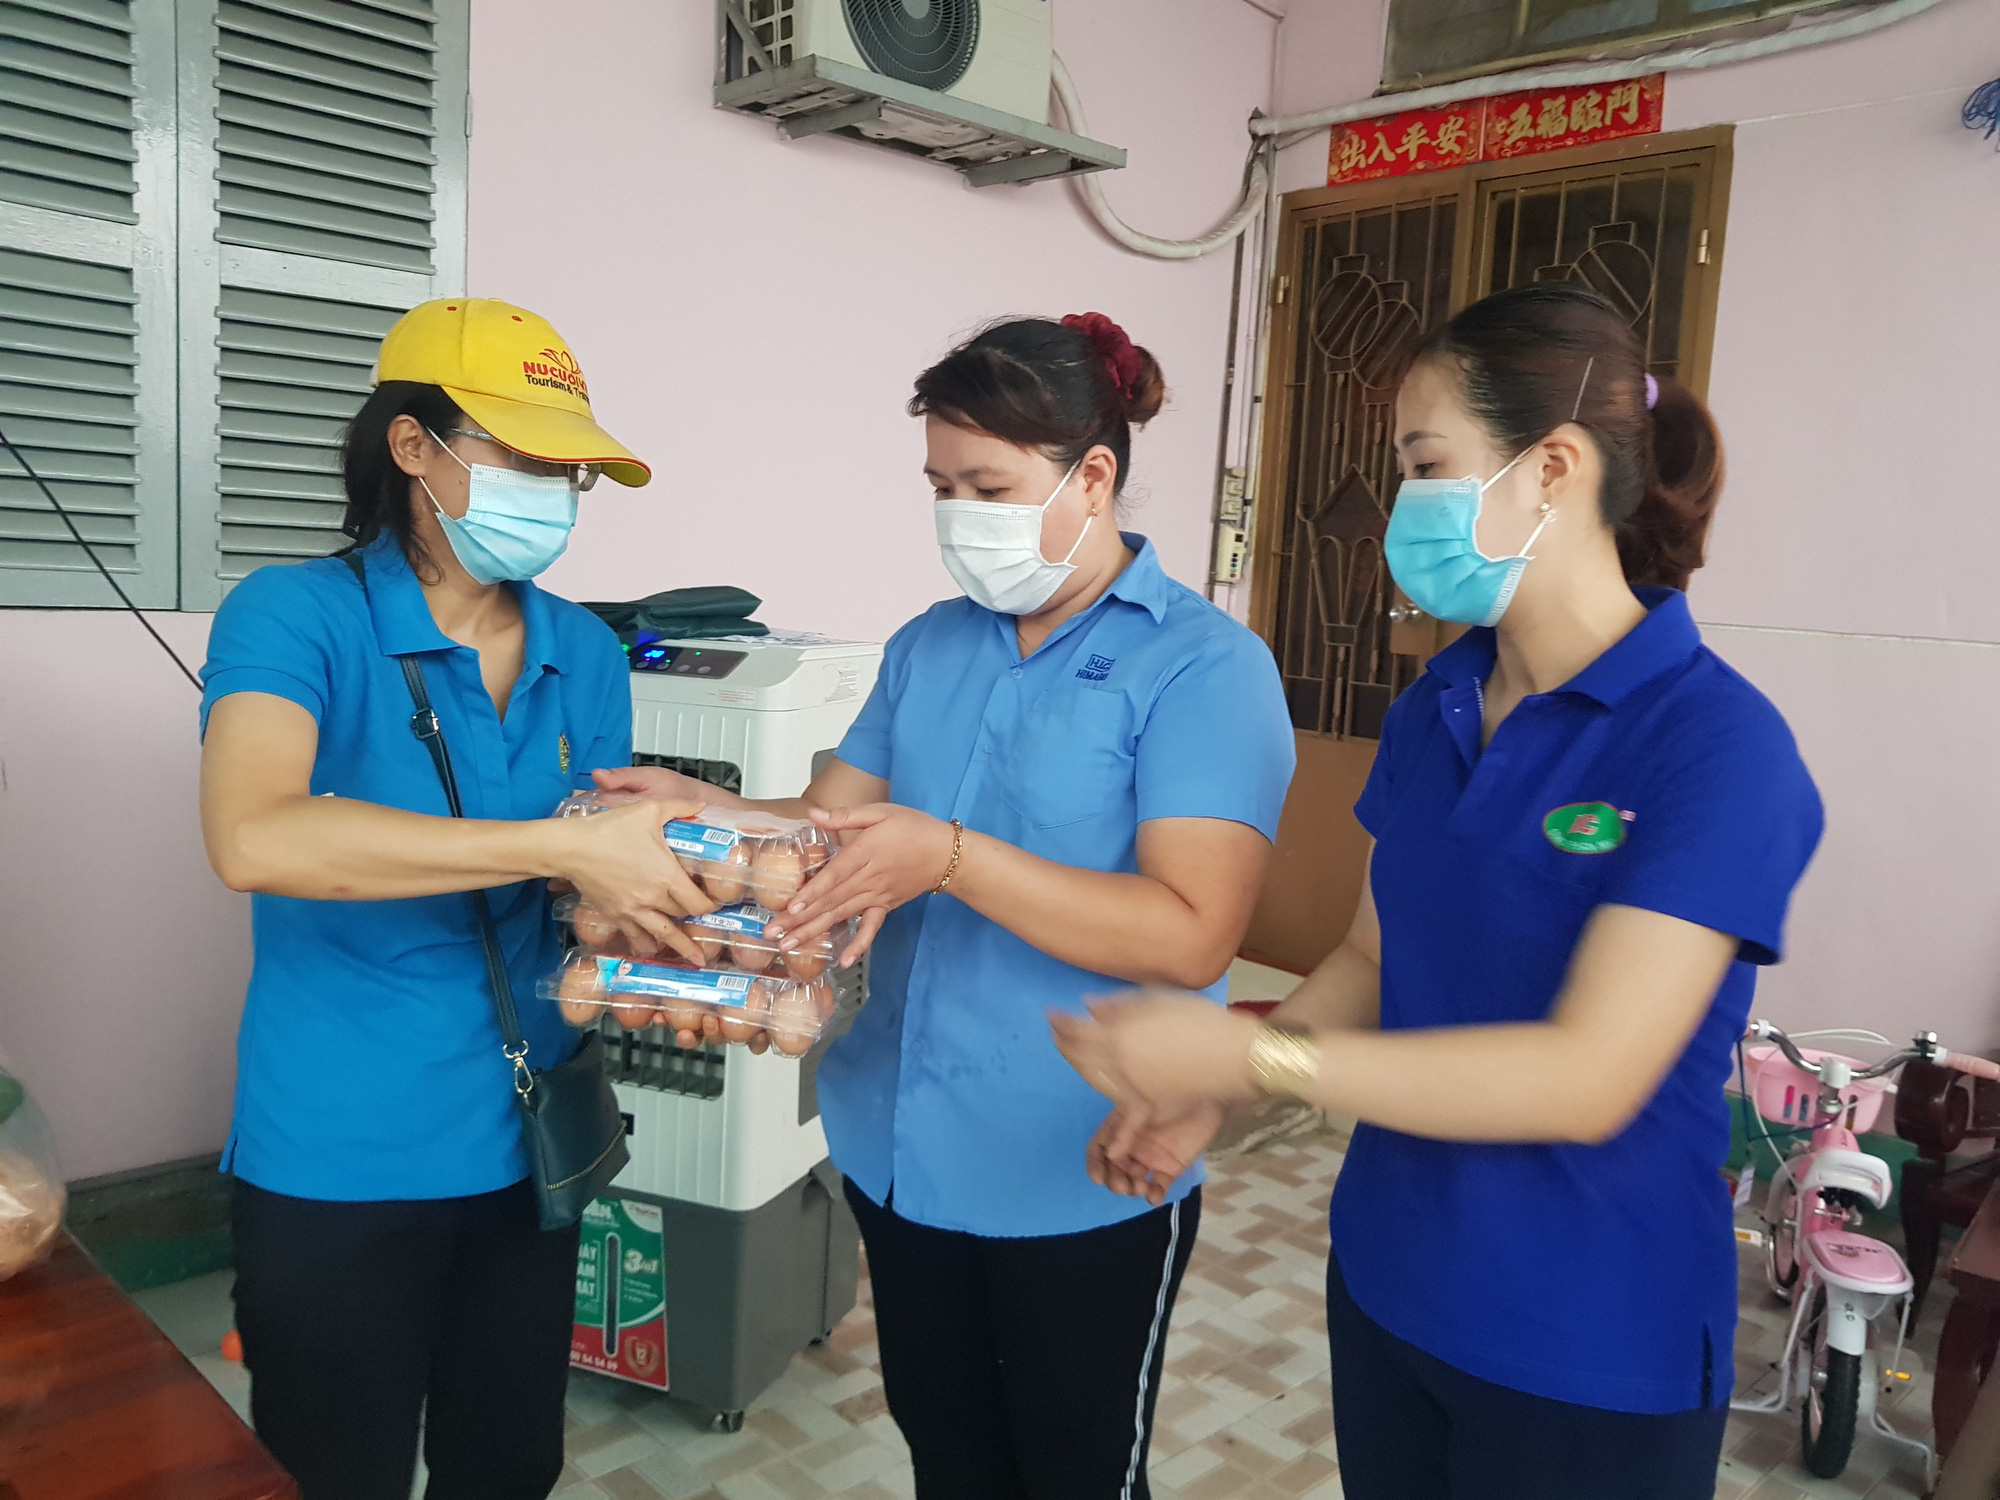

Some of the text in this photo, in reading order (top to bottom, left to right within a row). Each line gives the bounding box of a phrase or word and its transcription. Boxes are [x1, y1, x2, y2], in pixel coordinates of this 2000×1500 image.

[1503, 82, 1641, 146] 五福臨門
[1340, 115, 1467, 171] 出入平安
[525, 374, 566, 392] Tourism
[566, 384, 574, 395] &
